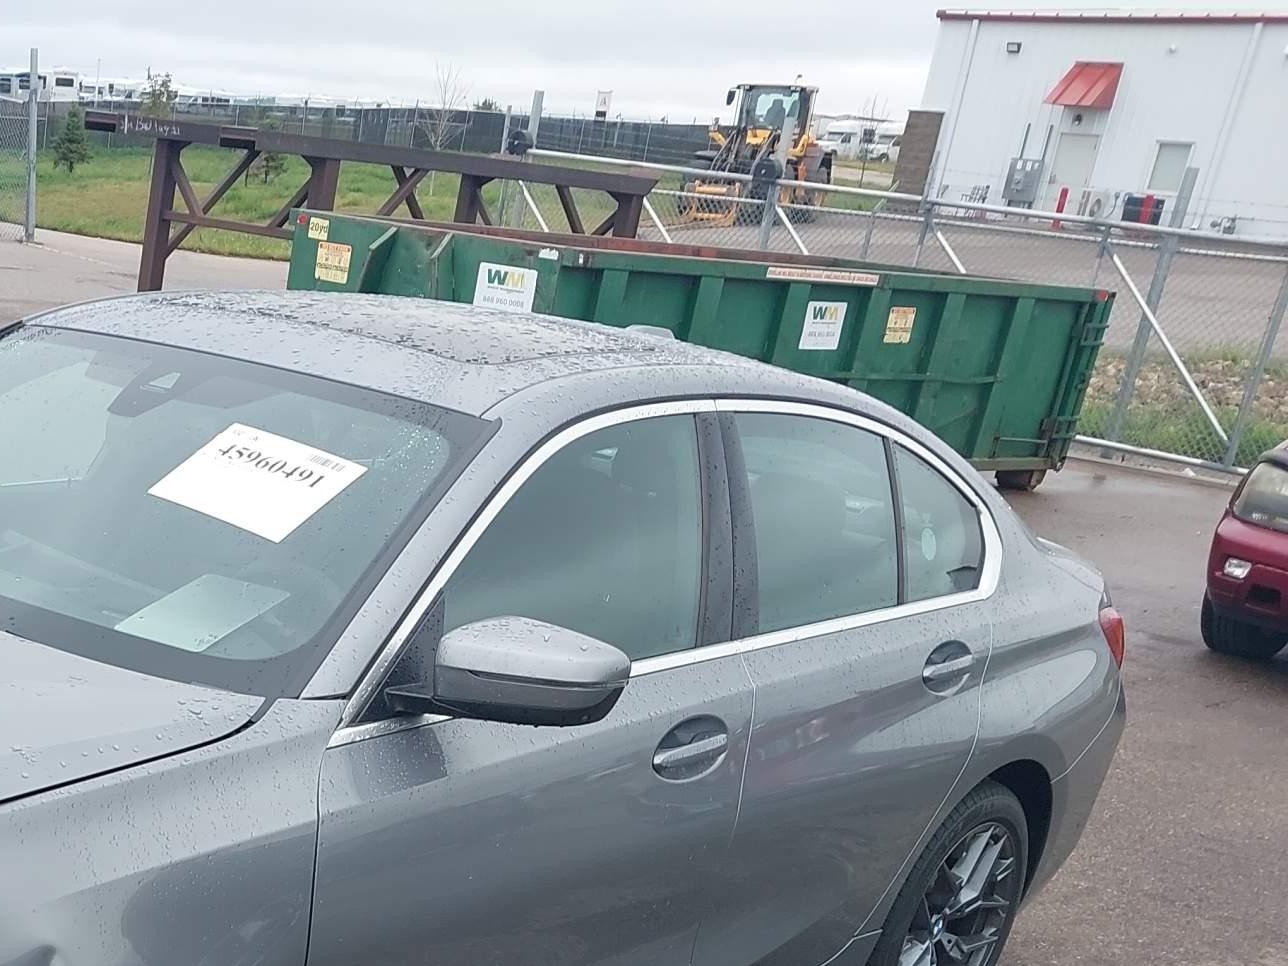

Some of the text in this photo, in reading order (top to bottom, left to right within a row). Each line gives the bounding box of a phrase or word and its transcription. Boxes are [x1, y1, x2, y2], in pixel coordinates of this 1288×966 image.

[310, 222, 329, 235] 20yd
[487, 268, 526, 289] WM
[218, 444, 325, 488] 45960491
